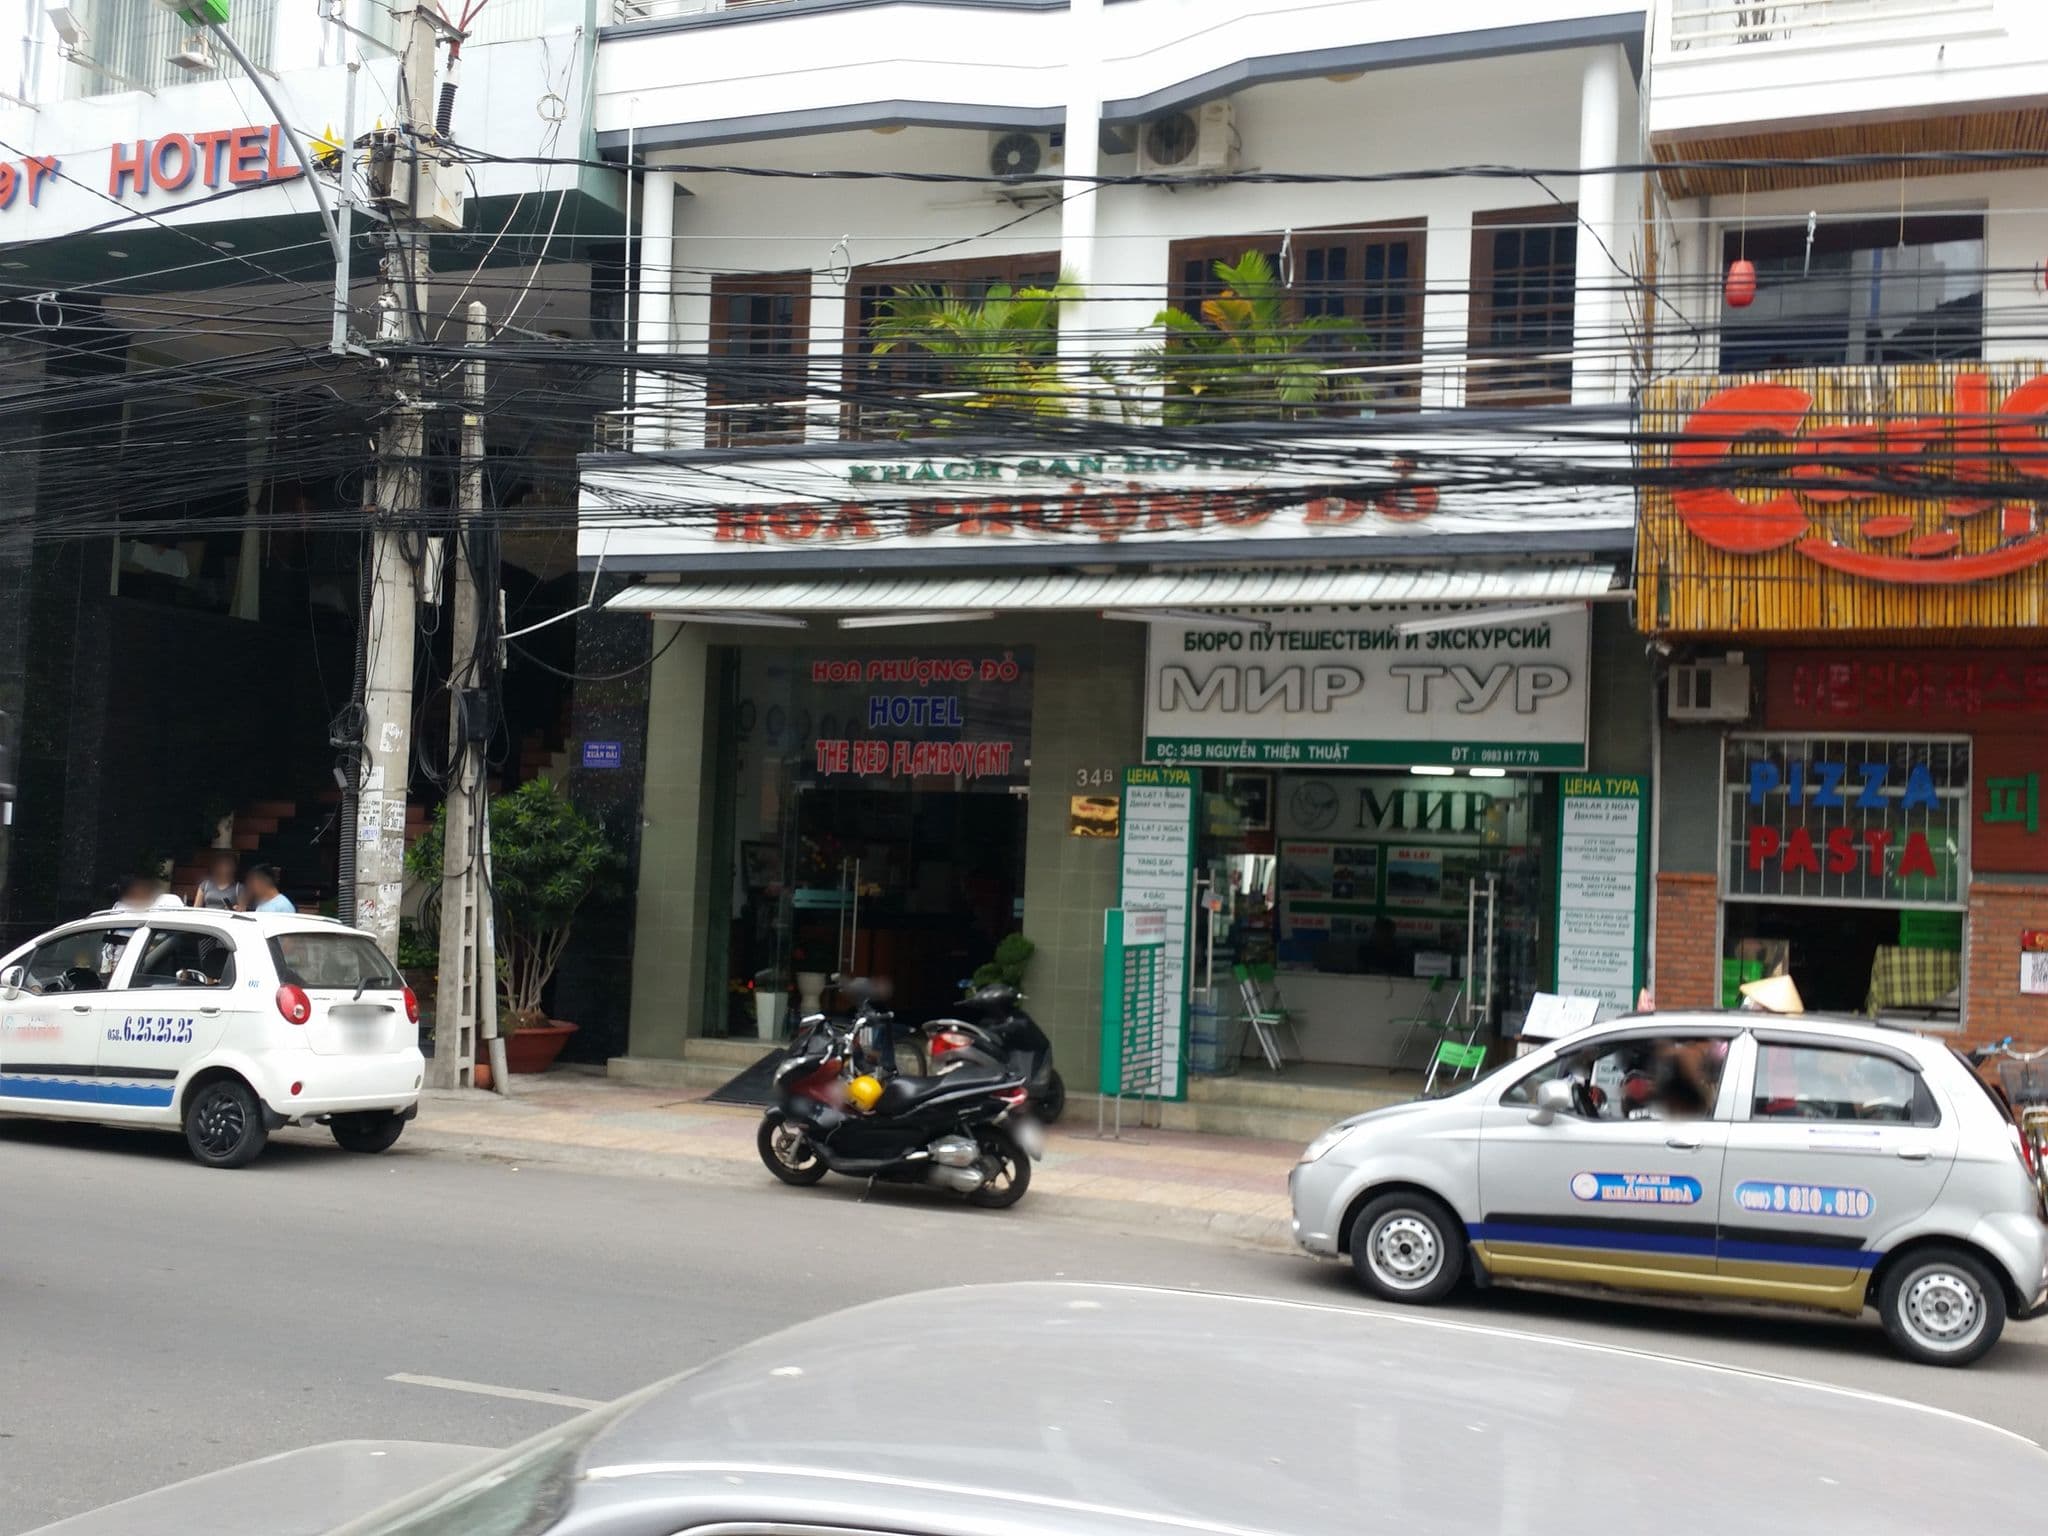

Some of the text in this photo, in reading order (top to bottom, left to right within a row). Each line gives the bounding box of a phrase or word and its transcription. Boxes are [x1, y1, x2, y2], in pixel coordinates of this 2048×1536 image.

[109, 123, 304, 197] HOTEL
[1184, 629, 1243, 652] БЮРО
[1426, 621, 1551, 650] ЭКСКУРСИЙ
[812, 659, 862, 682] HOA
[1159, 664, 1571, 715] МИР ТУР
[869, 695, 964, 729] HOTEL
[815, 738, 1013, 779] THE RED FLAMBOYANT
[1180, 743, 1202, 758] 34B
[1127, 768, 1191, 785] ЦЕНА ТУРА
[1564, 778, 1640, 797] ЦЕНА ТУРА
[1749, 758, 1941, 810] PIZZA
[1982, 771, 2041, 834] 피
[1749, 825, 1938, 879] PASTA
